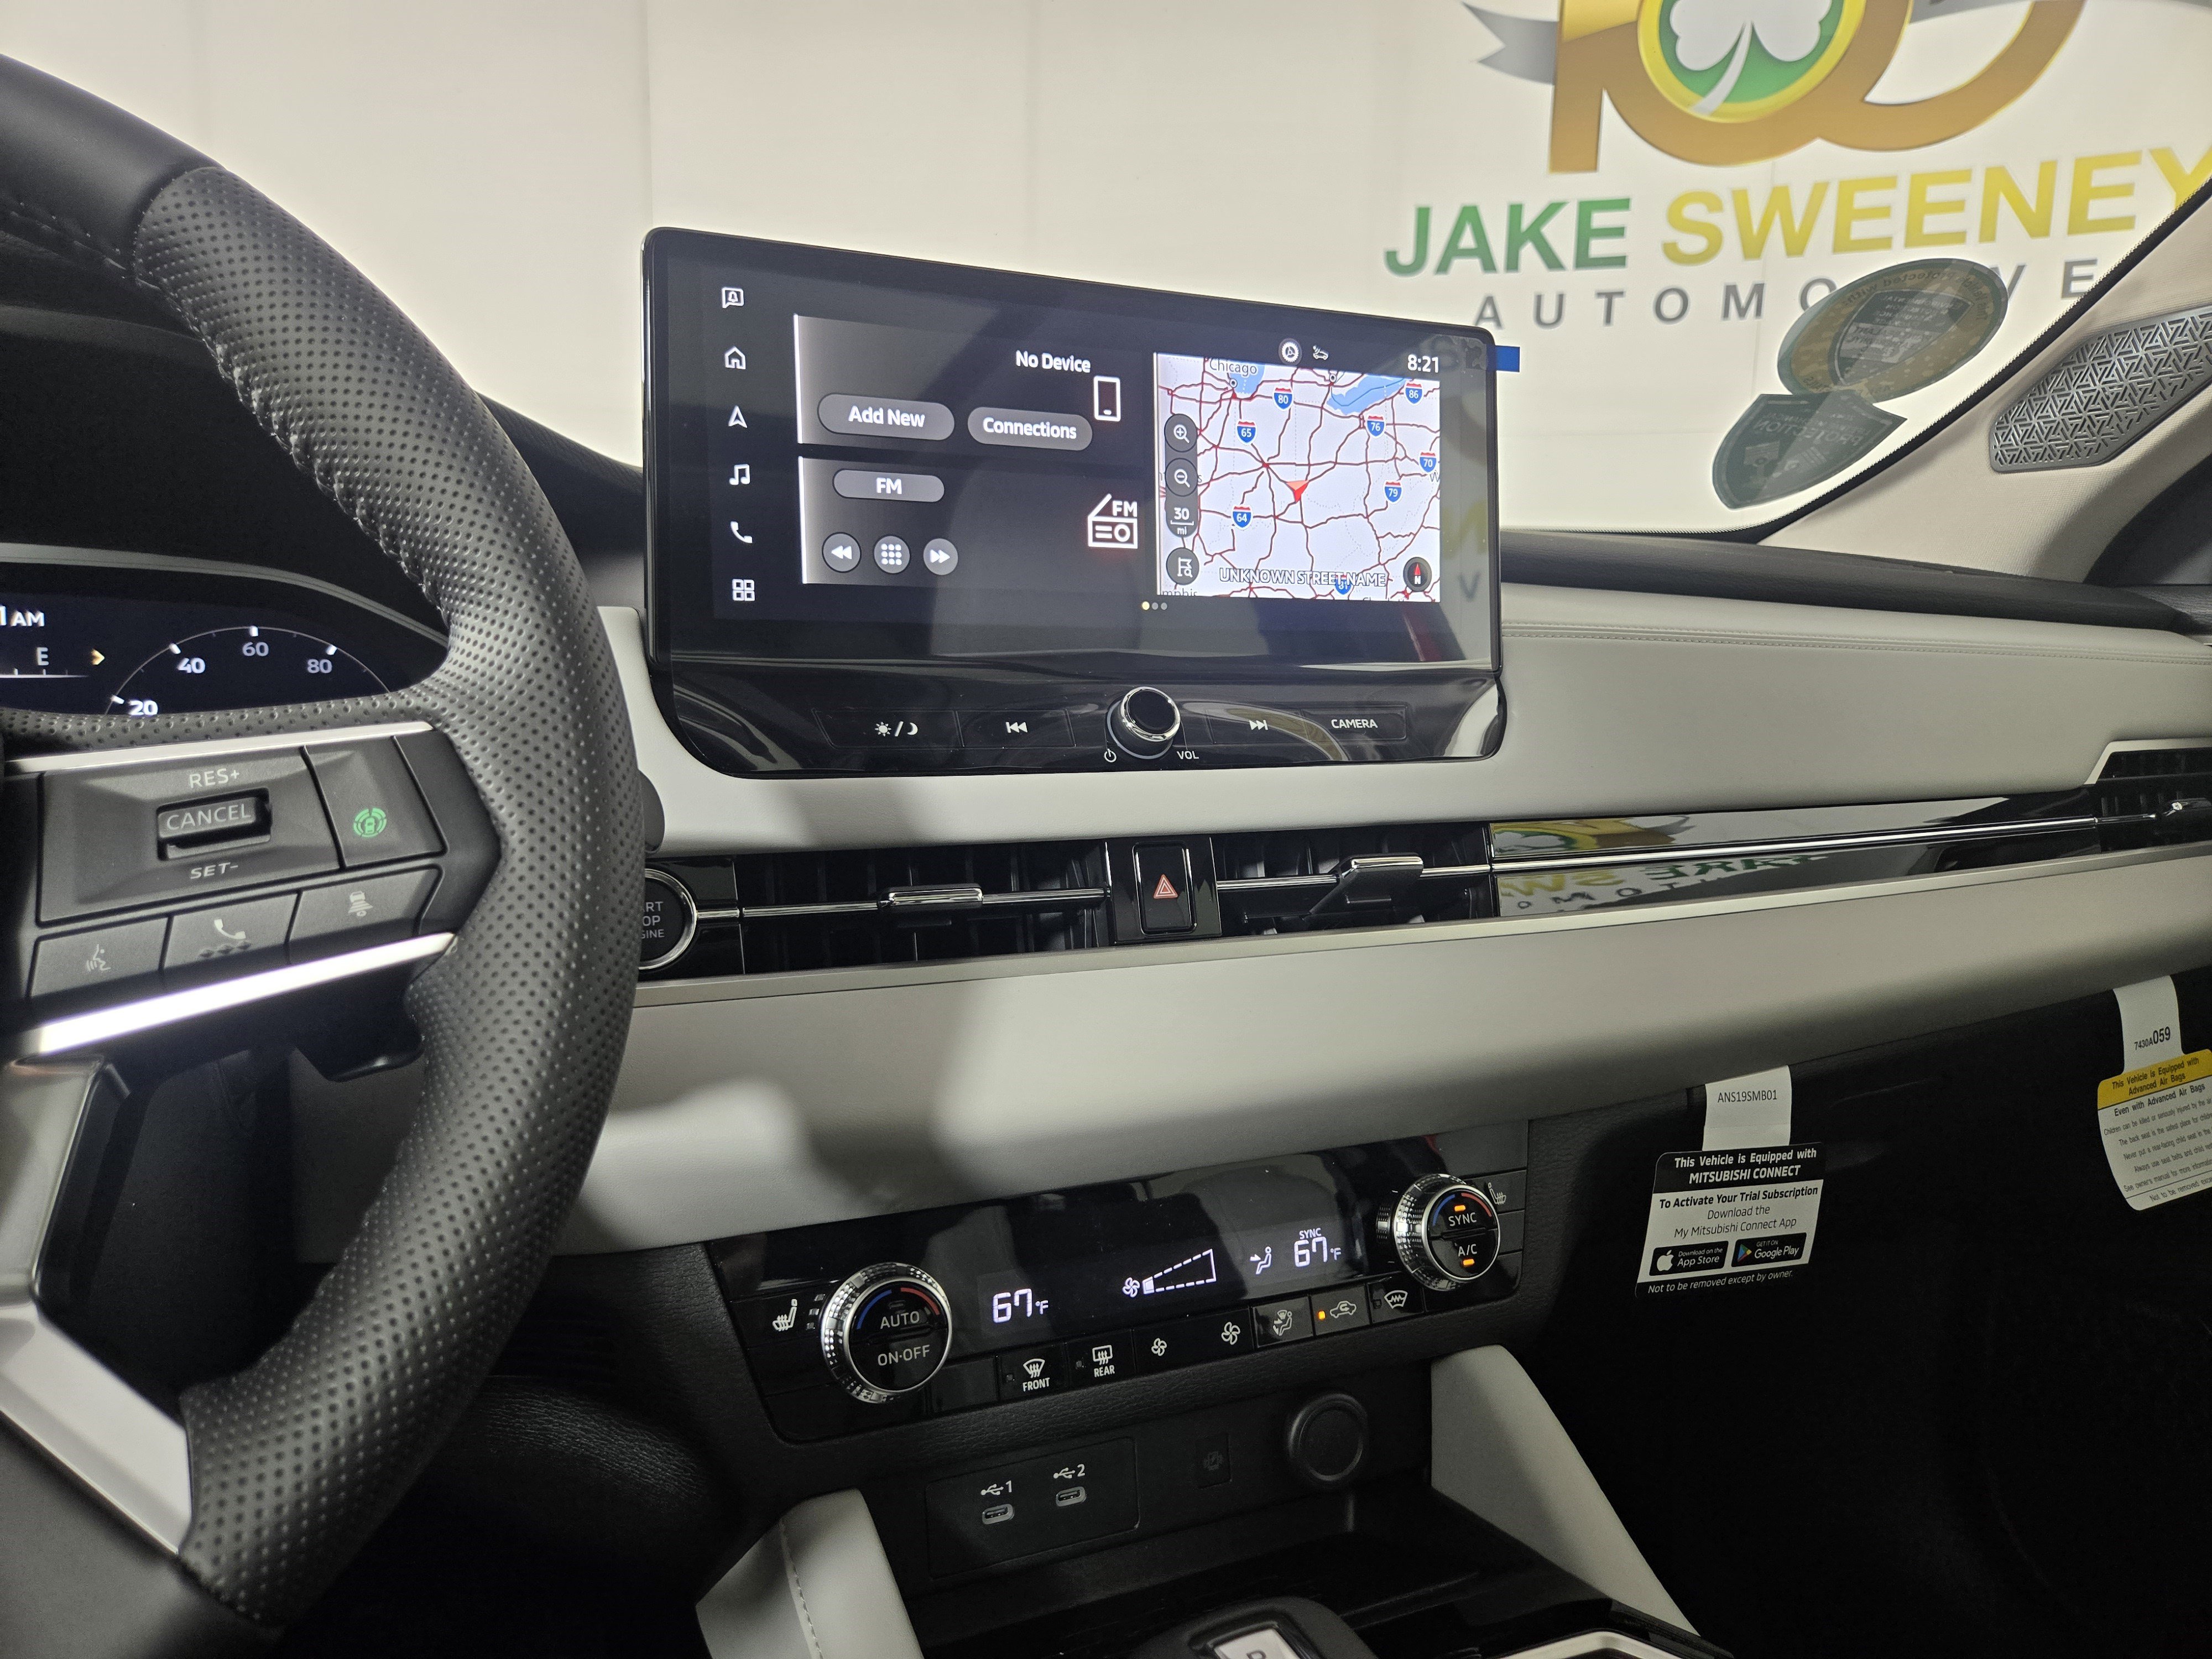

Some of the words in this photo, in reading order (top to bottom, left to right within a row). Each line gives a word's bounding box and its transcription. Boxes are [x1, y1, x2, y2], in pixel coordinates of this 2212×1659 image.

[1384, 197, 1631, 276] JAKE
[1661, 145, 2212, 266] SWEENEY
[1016, 350, 1039, 368] No
[1042, 353, 1091, 373] Device
[1209, 359, 1257, 377] Chicago
[1407, 354, 1438, 373] 8:21
[1278, 394, 1288, 404] 80
[1408, 390, 1418, 399] 86
[848, 405, 883, 425] Add
[887, 409, 925, 427] New
[983, 417, 1077, 439] Connections
[1240, 428, 1252, 437] 65
[1371, 422, 1381, 432] 76
[1423, 458, 1433, 467] 70
[876, 477, 902, 495] FM
[1389, 488, 1398, 497] 79
[1112, 500, 1138, 517] FM
[1174, 507, 1190, 520] 30
[1237, 513, 1248, 523] 64
[1177, 526, 1187, 535] mi
[1219, 567, 1295, 584] UNKNOWN
[1297, 571, 1344, 586] STREET
[1346, 572, 1386, 587] NAME
[1414, 575, 1421, 585] N
[11, 611, 45, 627] AM
[36, 647, 49, 666] E
[242, 641, 269, 656] 60
[177, 658, 206, 674] 40
[307, 659, 332, 674] 80
[129, 700, 159, 716] 20
[1331, 718, 1378, 729] CAMERA
[1177, 750, 1199, 760] VOL
[189, 768, 240, 789] RES+
[166, 804, 251, 830] CANCEL
[190, 862, 238, 879] SET-
[2134, 1026, 2171, 1051] 7430A059
[2112, 1081, 2124, 1090] This
[2127, 1073, 2148, 1085] Vehicle
[2158, 1062, 2184, 1075] Equipped
[2187, 1057, 2199, 1067] with
[2129, 1082, 2157, 1096] Advanced
[2159, 1078, 2168, 1086] Air
[2171, 1072, 2186, 1083] Bags
[1717, 1089, 1777, 1103] ANS19SMB01
[2114, 1105, 2129, 1117] Even
[2131, 1101, 2145, 1111] with
[2148, 1091, 2176, 1107] Advanced
[2179, 1087, 2187, 1097] Air
[2190, 1083, 2205, 1093] Bags
[1674, 1156, 1695, 1168] This
[1699, 1154, 1734, 1166] Vehicle
[1738, 1153, 1746, 1164] is
[1750, 1150, 1793, 1164] Equipped
[1797, 1148, 1817, 1159] with
[1689, 1169, 1750, 1184] MITSUBISHI
[1753, 1165, 1801, 1179] CONNECT
[1660, 1198, 1671, 1208] To
[1673, 1195, 1713, 1208] Activate
[1717, 1193, 1738, 1204] Your
[1740, 1191, 1760, 1202] Trial
[1762, 1186, 1818, 1200] Subscription
[1448, 1212, 1477, 1227] SYNC
[1707, 1207, 1752, 1220] Download
[1755, 1205, 1770, 1215] the
[1299, 1227, 1322, 1239] SYNC
[1674, 1228, 1689, 1239] My
[1691, 1223, 1738, 1237] Mitsubishi
[1740, 1219, 1777, 1231] Connect
[1779, 1218, 1797, 1229] App
[1458, 1244, 1478, 1257] A/C
[1754, 1248, 1782, 1260] Google
[1783, 1245, 1799, 1257] Play
[1677, 1258, 1696, 1268] App
[1698, 1255, 1720, 1265] Store
[1648, 1285, 1665, 1293] Not
[1666, 1284, 1675, 1292] to
[1677, 1281, 1688, 1290] be
[1690, 1276, 1726, 1289] removed
[1728, 1274, 1755, 1285] except
[1756, 1272, 1767, 1282] by
[1768, 1270, 1793, 1280] owner.
[880, 1311, 920, 1329] AUTO
[1093, 1364, 1115, 1378] REAR
[1022, 1377, 1050, 1392] FRONT
[1076, 1463, 1086, 1477] 2
[1005, 1480, 1013, 1493] 1
